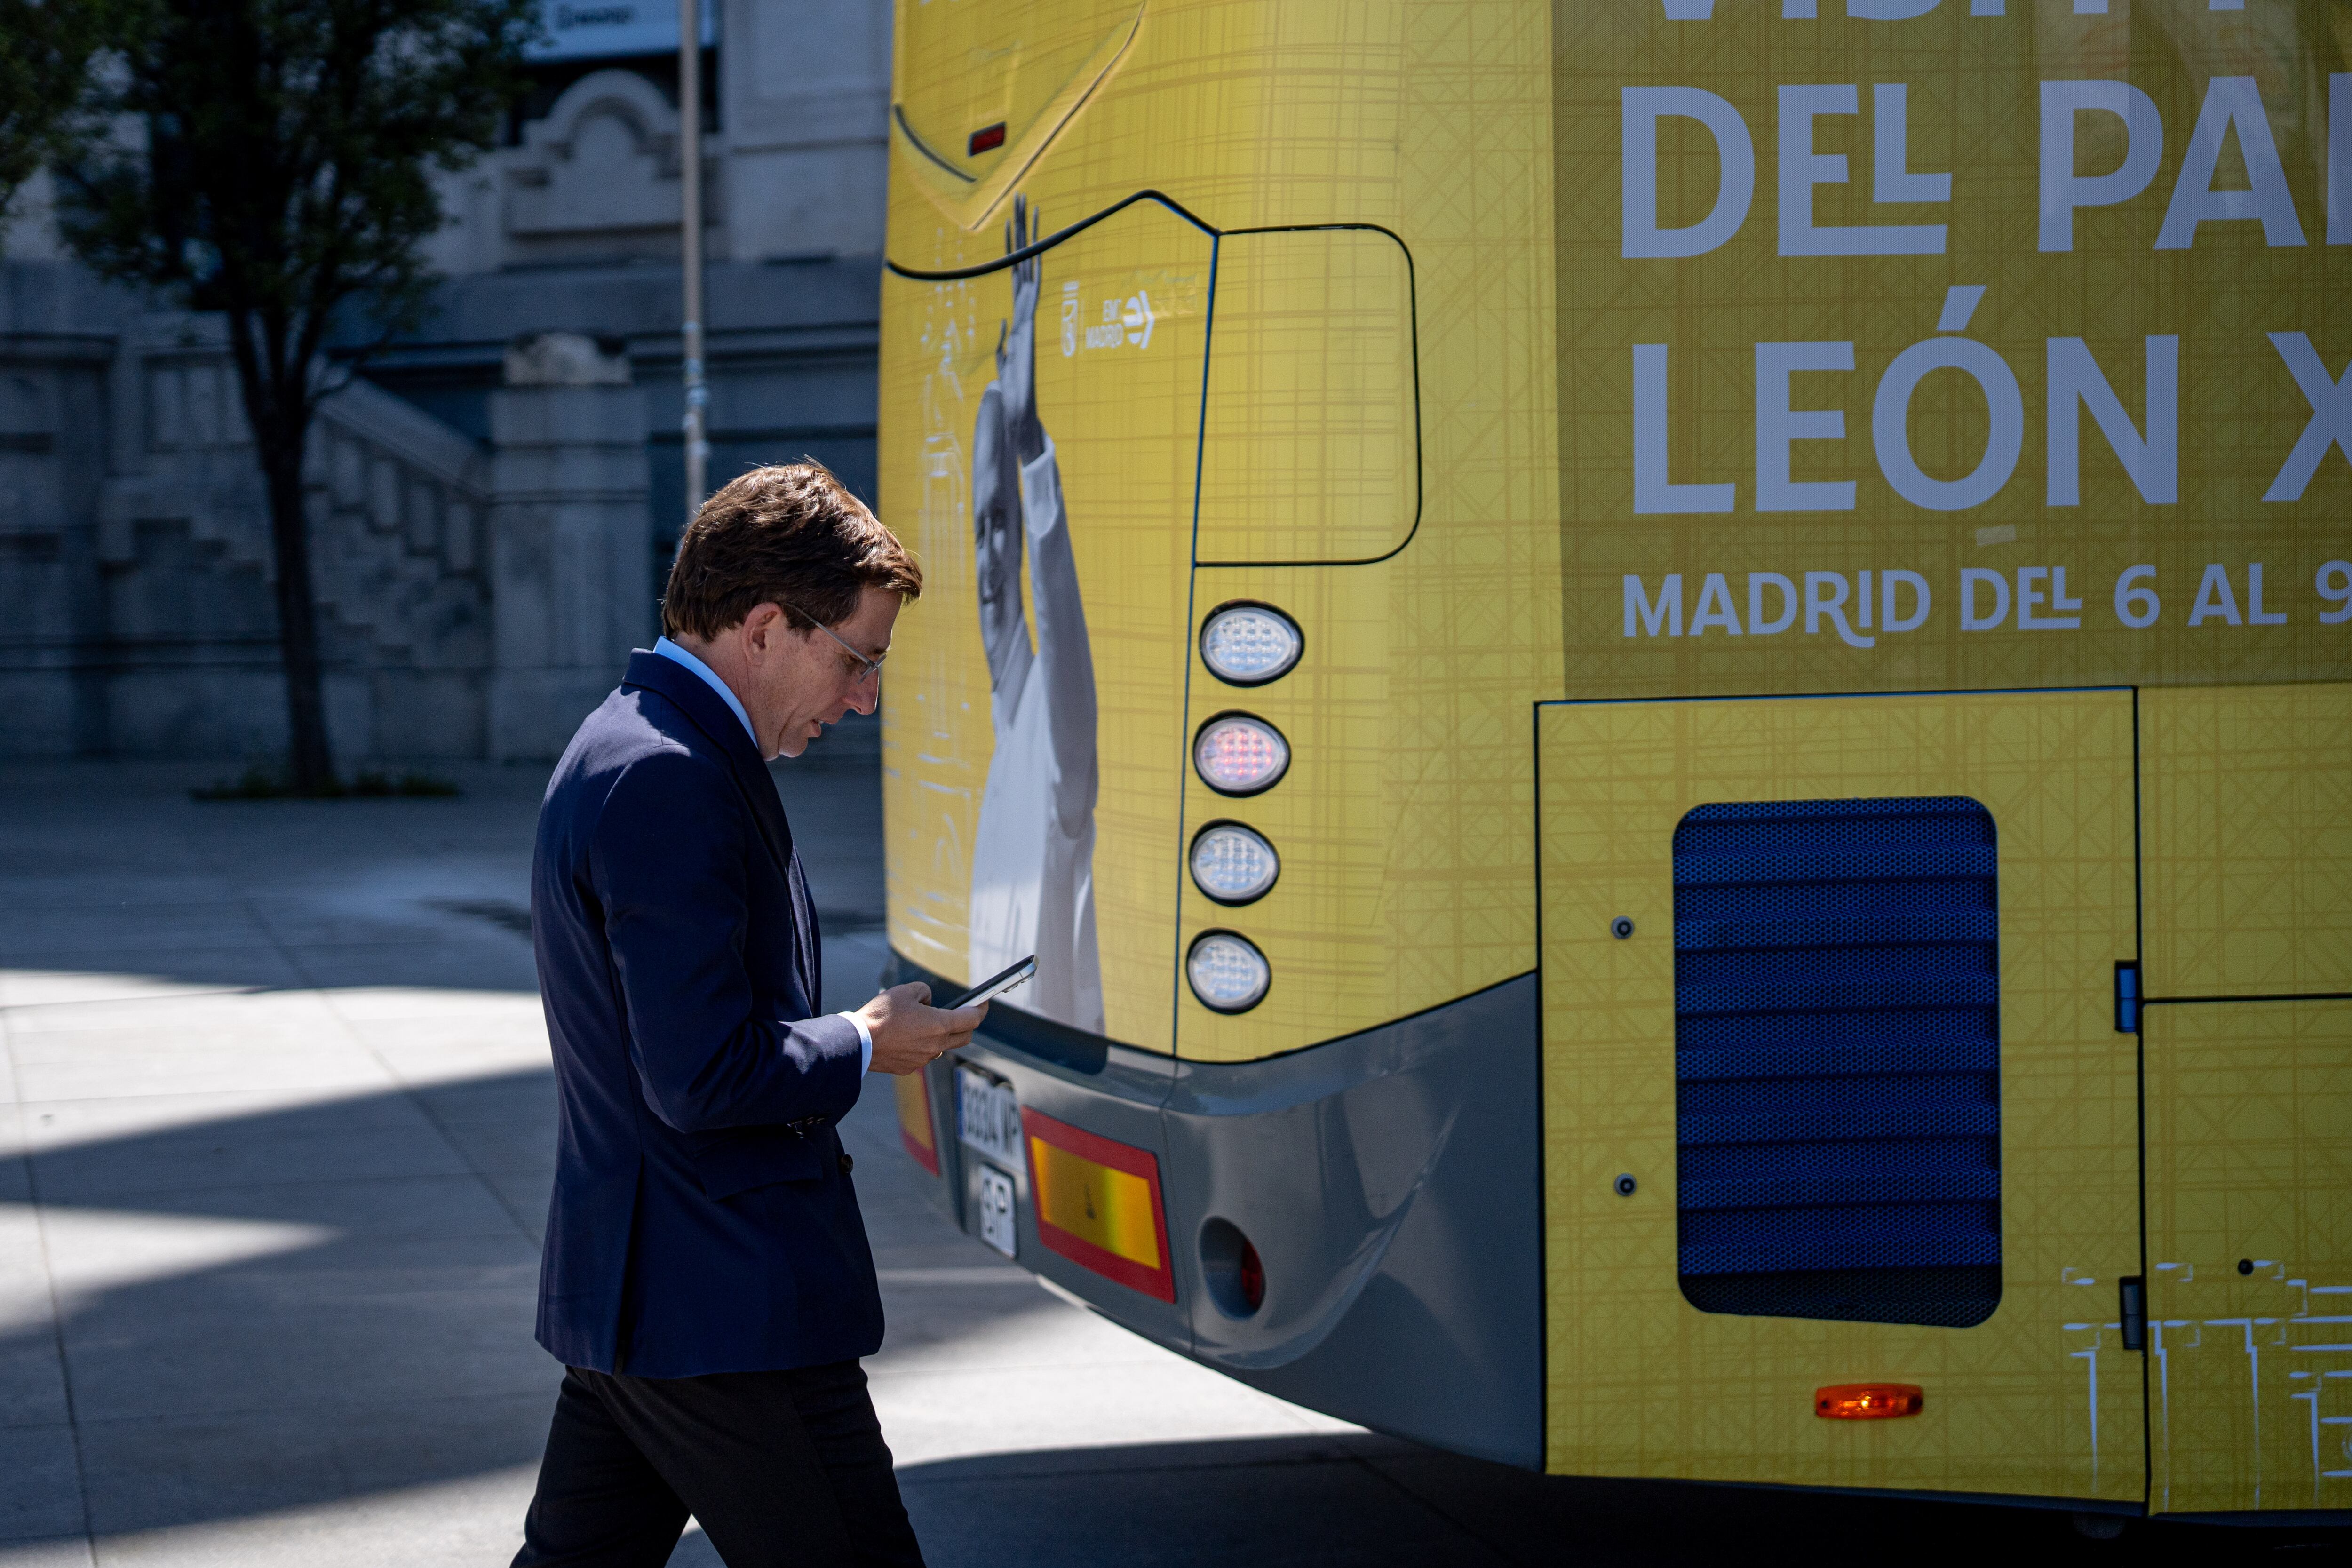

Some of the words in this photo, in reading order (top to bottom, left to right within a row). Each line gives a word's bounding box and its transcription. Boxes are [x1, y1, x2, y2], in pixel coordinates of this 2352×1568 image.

[1621, 83, 1952, 258] DEL
[1633, 285, 2179, 514] LEÓN
[1623, 570, 1932, 649] MADRID
[1960, 566, 2082, 631] DEL
[2114, 565, 2161, 628] 6
[2188, 562, 2287, 626] AL
[2315, 560, 2352, 624] 9
